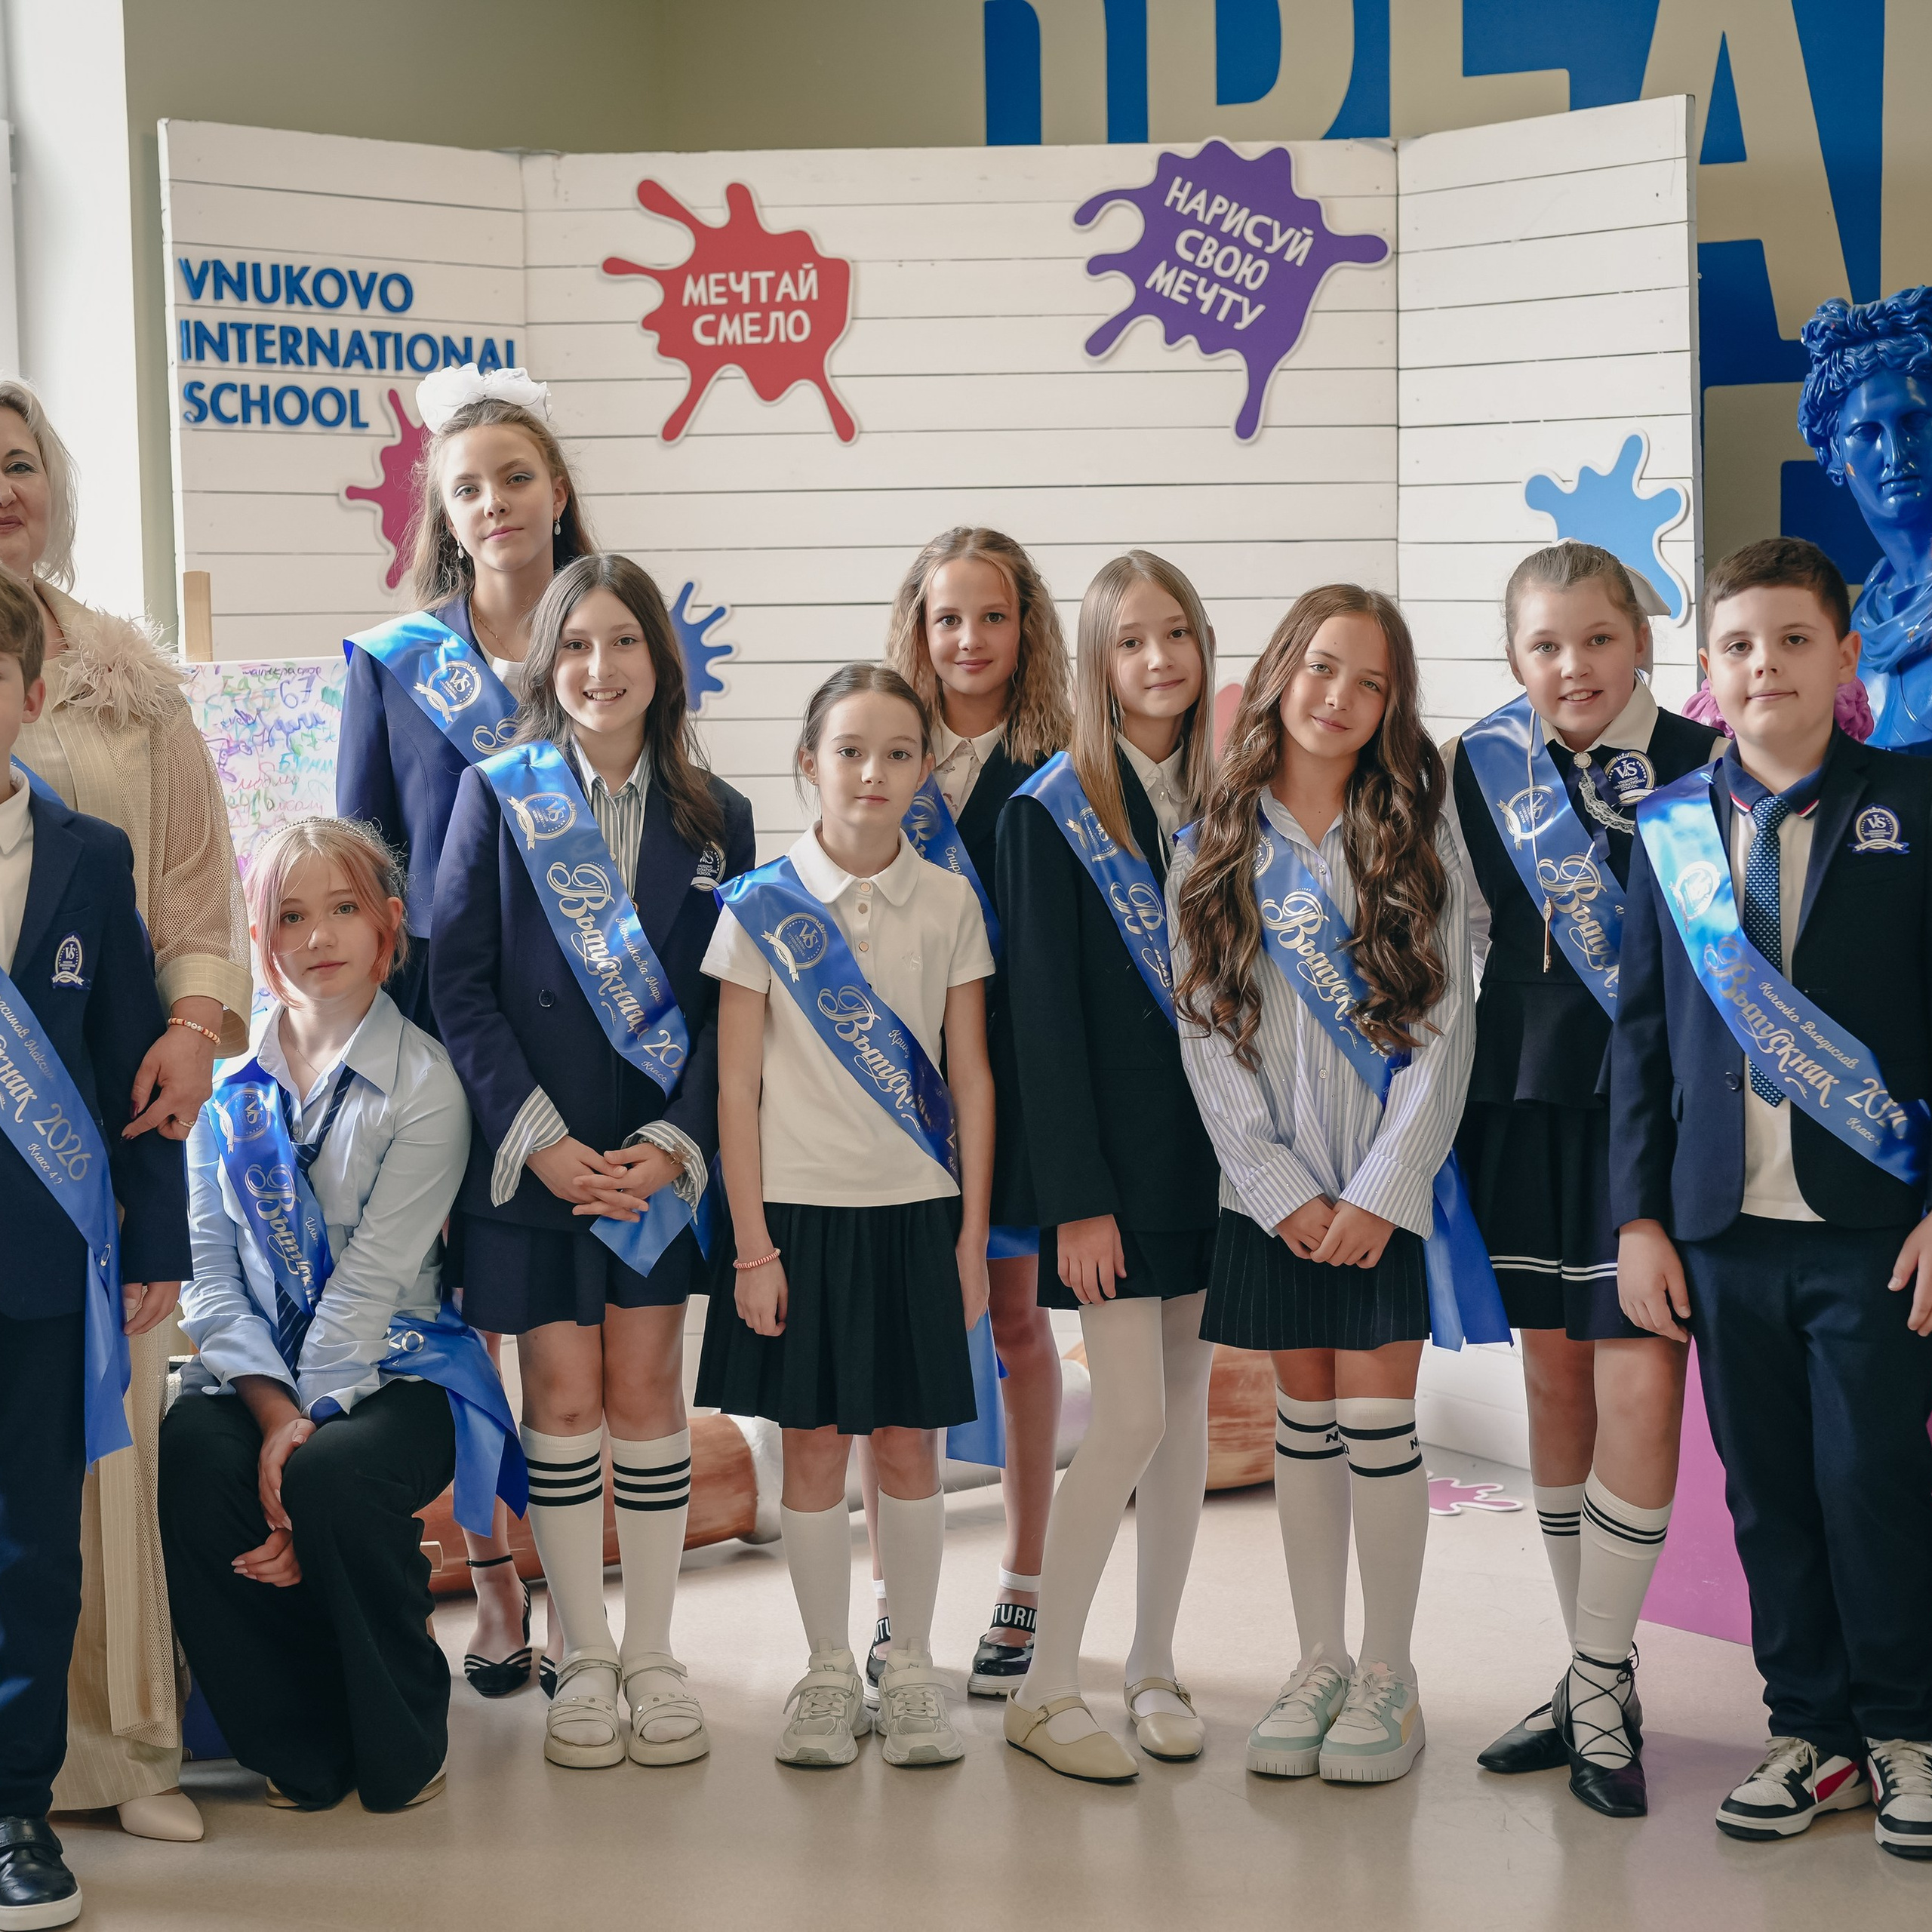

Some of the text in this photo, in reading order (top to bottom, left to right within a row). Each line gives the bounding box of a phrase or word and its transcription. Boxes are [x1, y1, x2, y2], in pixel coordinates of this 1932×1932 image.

[1164, 176, 1314, 267] НАРИСУЙ
[1175, 229, 1269, 291] СВОЮ
[178, 257, 414, 313] VNUKOVO
[682, 263, 819, 307] МЕЧТАЙ
[1145, 260, 1266, 331] МЕЧТУ
[692, 309, 811, 346] СМЕЛО
[183, 380, 370, 429] SCHOOL
[0, 995, 29, 1039] асимов
[1800, 1020, 1860, 1070] Владислав
[32, 1103, 93, 1182] 2026
[1845, 1116, 1876, 1143] Класс
[27, 1143, 51, 1174] Класс
